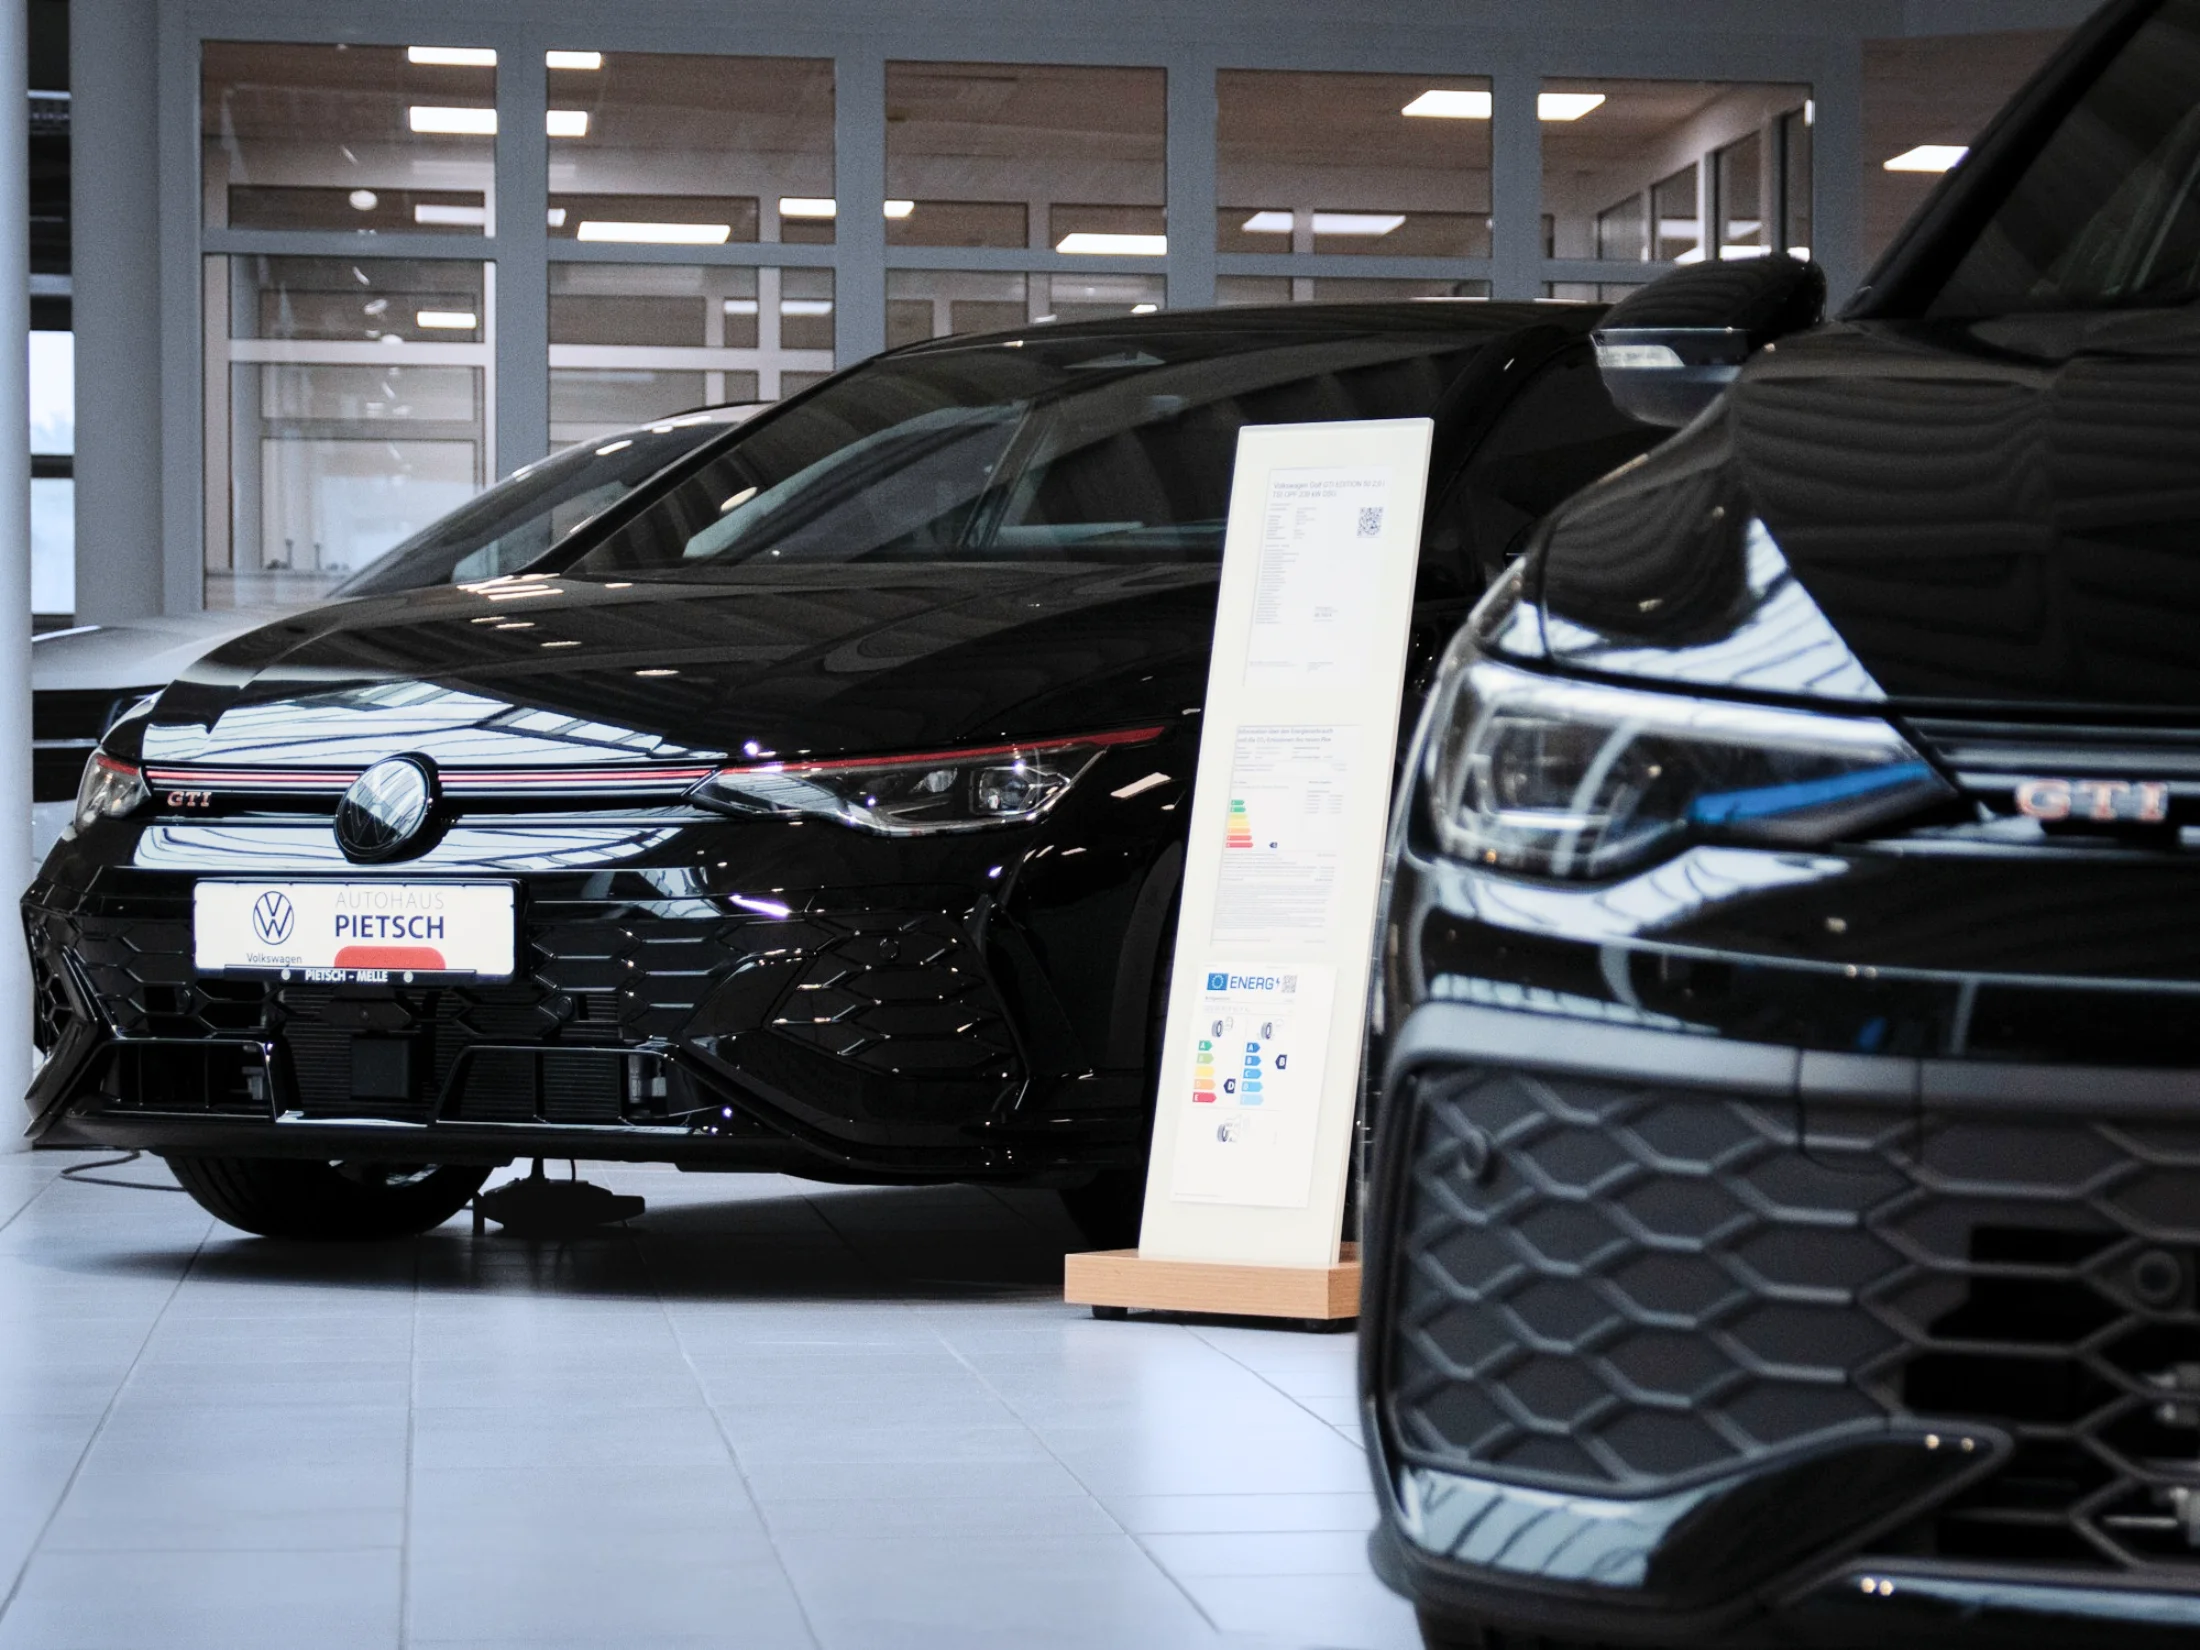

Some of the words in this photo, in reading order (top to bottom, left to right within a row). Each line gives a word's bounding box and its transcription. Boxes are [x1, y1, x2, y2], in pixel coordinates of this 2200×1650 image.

[167, 791, 212, 807] GTI
[2015, 778, 2168, 821] GTI
[335, 891, 445, 910] AUTOHAUS
[335, 915, 444, 939] PIETSCH
[246, 952, 302, 965] Volkswagen
[305, 969, 346, 982] PIETSCH
[356, 970, 389, 983] MELLE
[1229, 976, 1275, 990] ENERG
[1227, 1081, 1235, 1090] D
